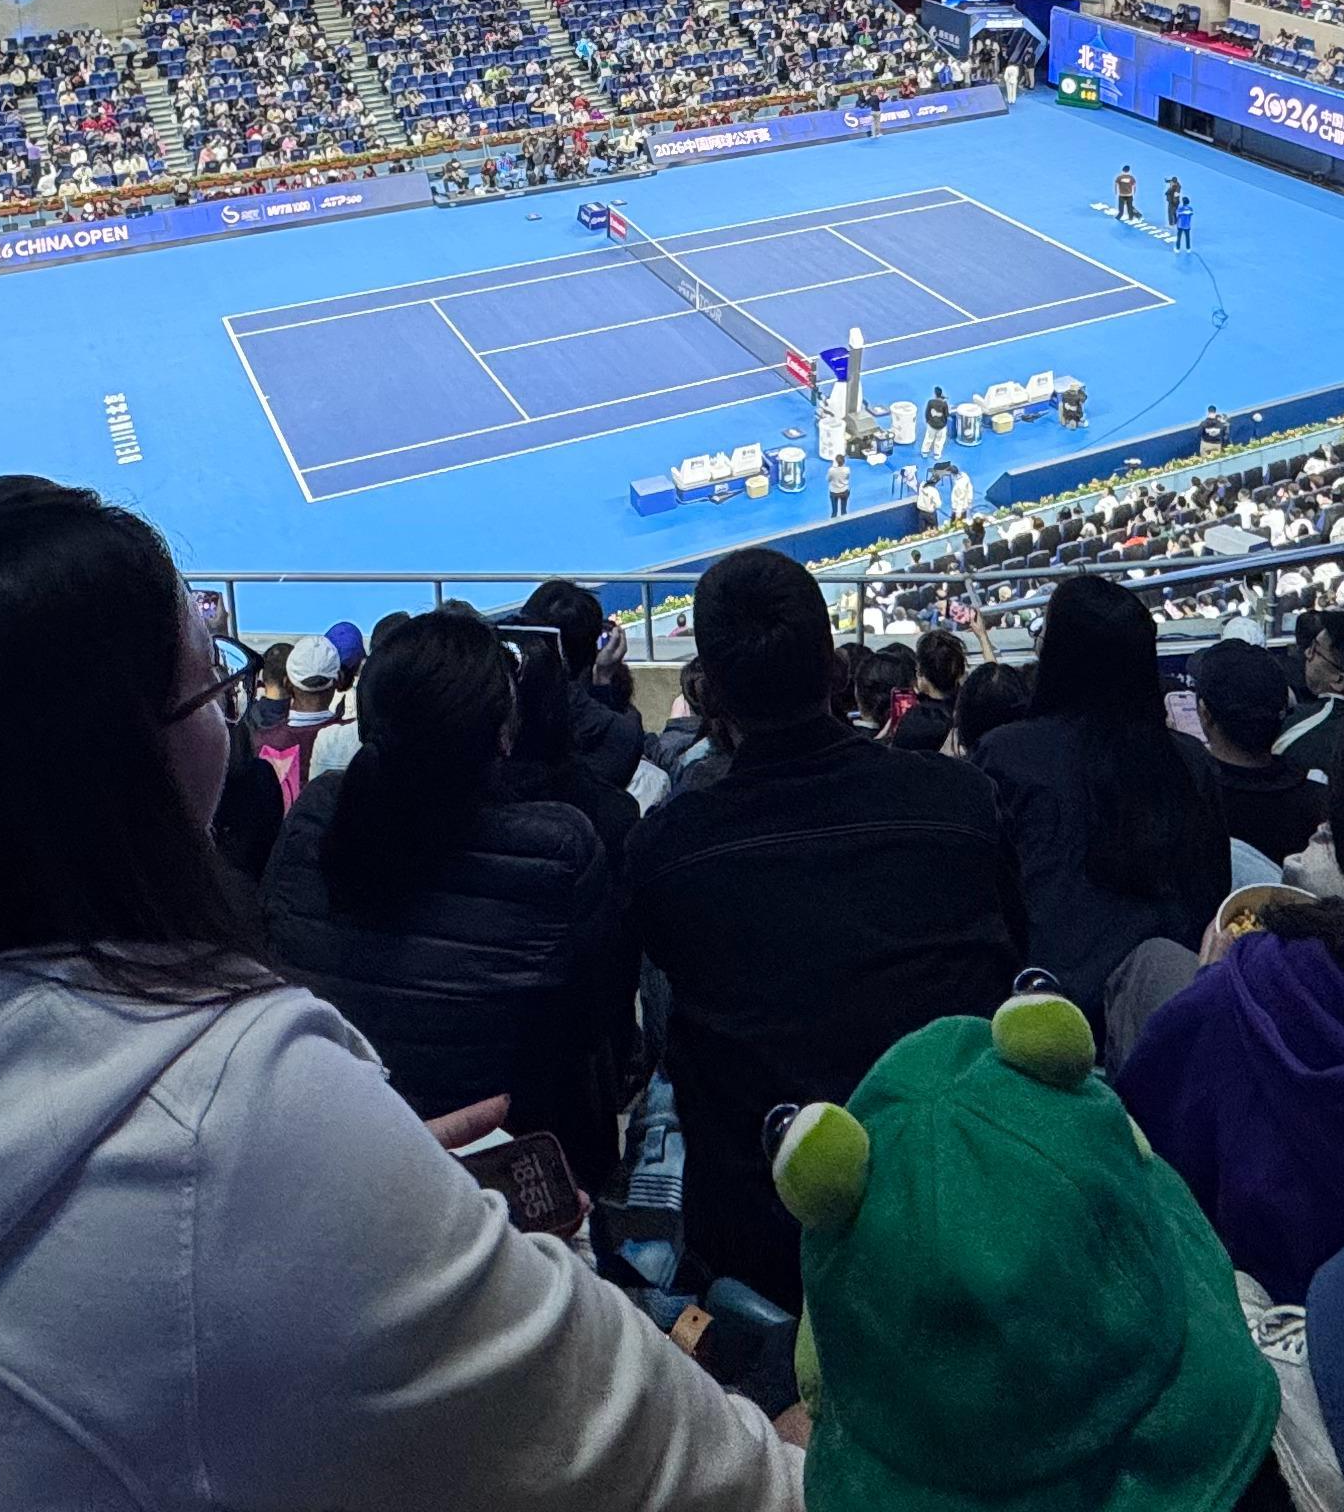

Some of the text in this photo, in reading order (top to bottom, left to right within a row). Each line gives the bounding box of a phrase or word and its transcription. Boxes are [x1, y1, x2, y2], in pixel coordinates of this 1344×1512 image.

[1077, 44, 1120, 80] 北京
[1247, 86, 1319, 135] 2026
[14, 234, 74, 258] CHINA
[74, 225, 129, 247] OPEN
